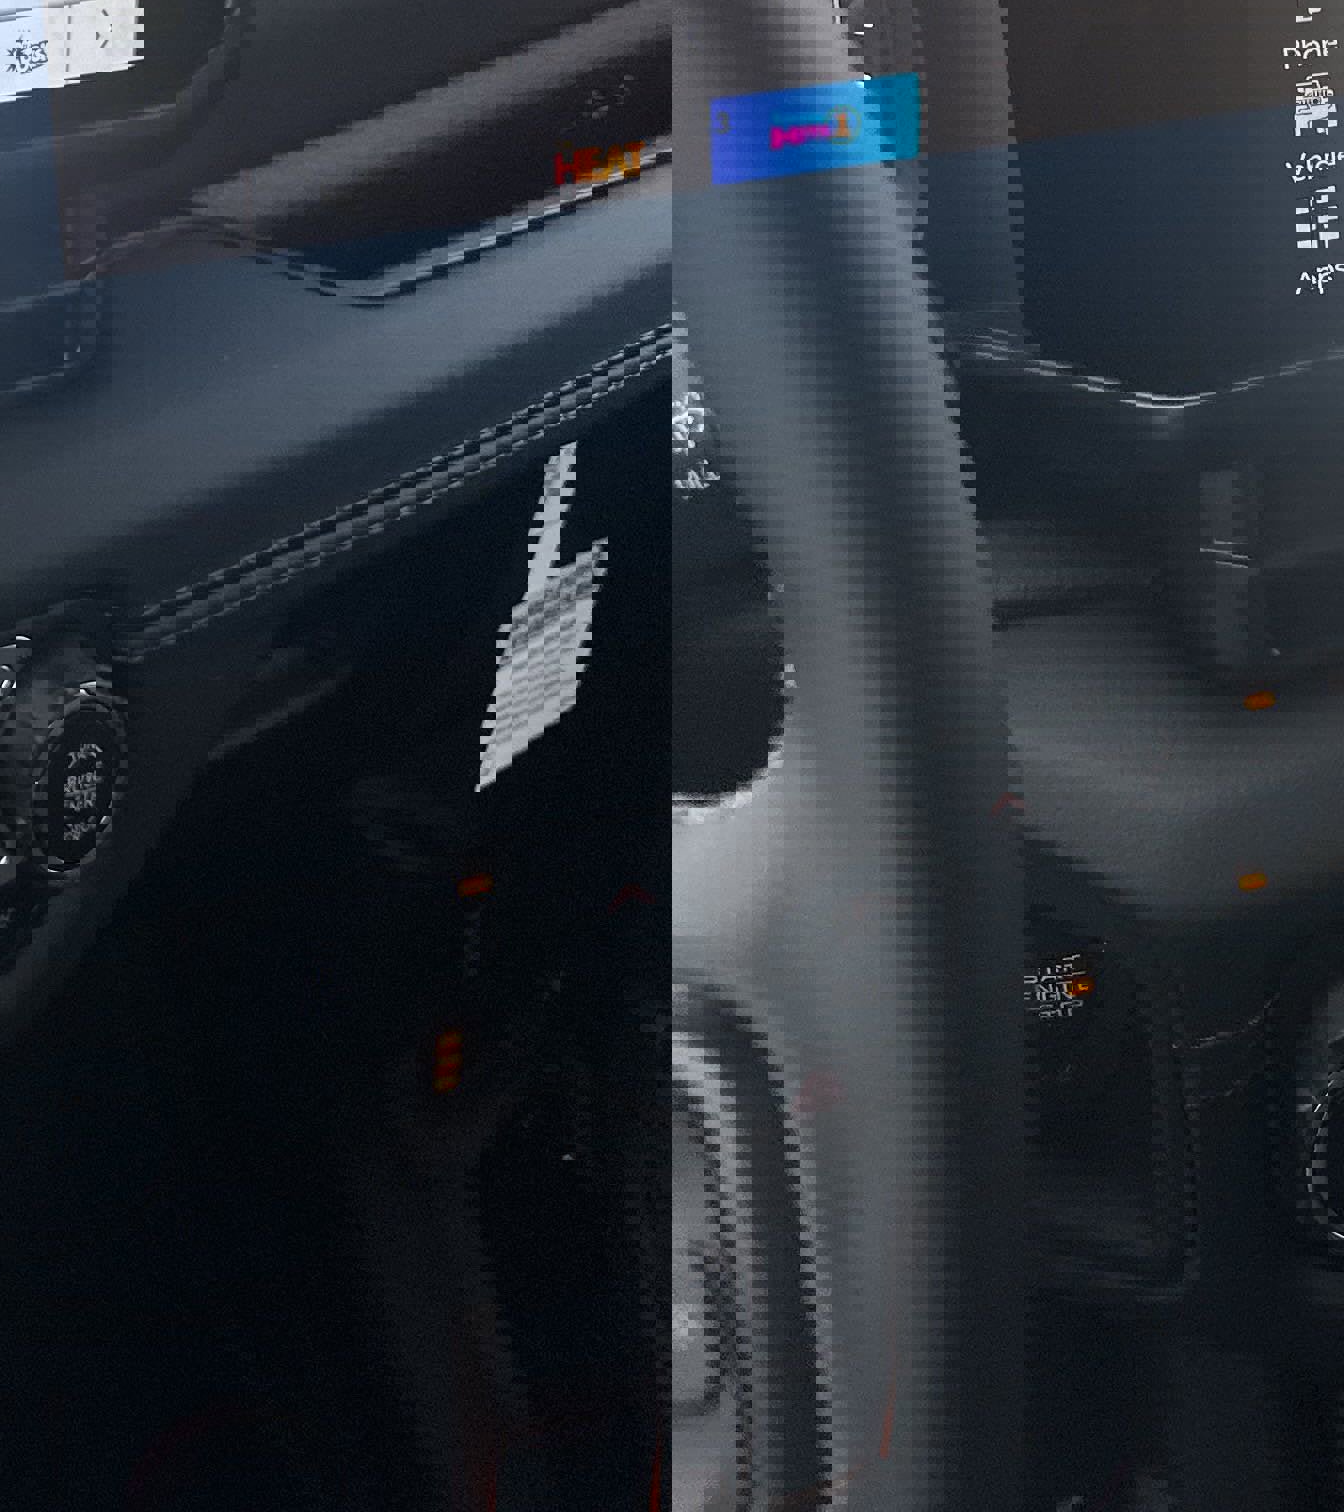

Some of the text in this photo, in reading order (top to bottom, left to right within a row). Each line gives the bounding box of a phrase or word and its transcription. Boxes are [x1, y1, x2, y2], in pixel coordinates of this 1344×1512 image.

[447, 36, 577, 80] Related
[554, 140, 646, 187] HEAT
[153, 189, 186, 215] All
[123, 221, 222, 253] Presets
